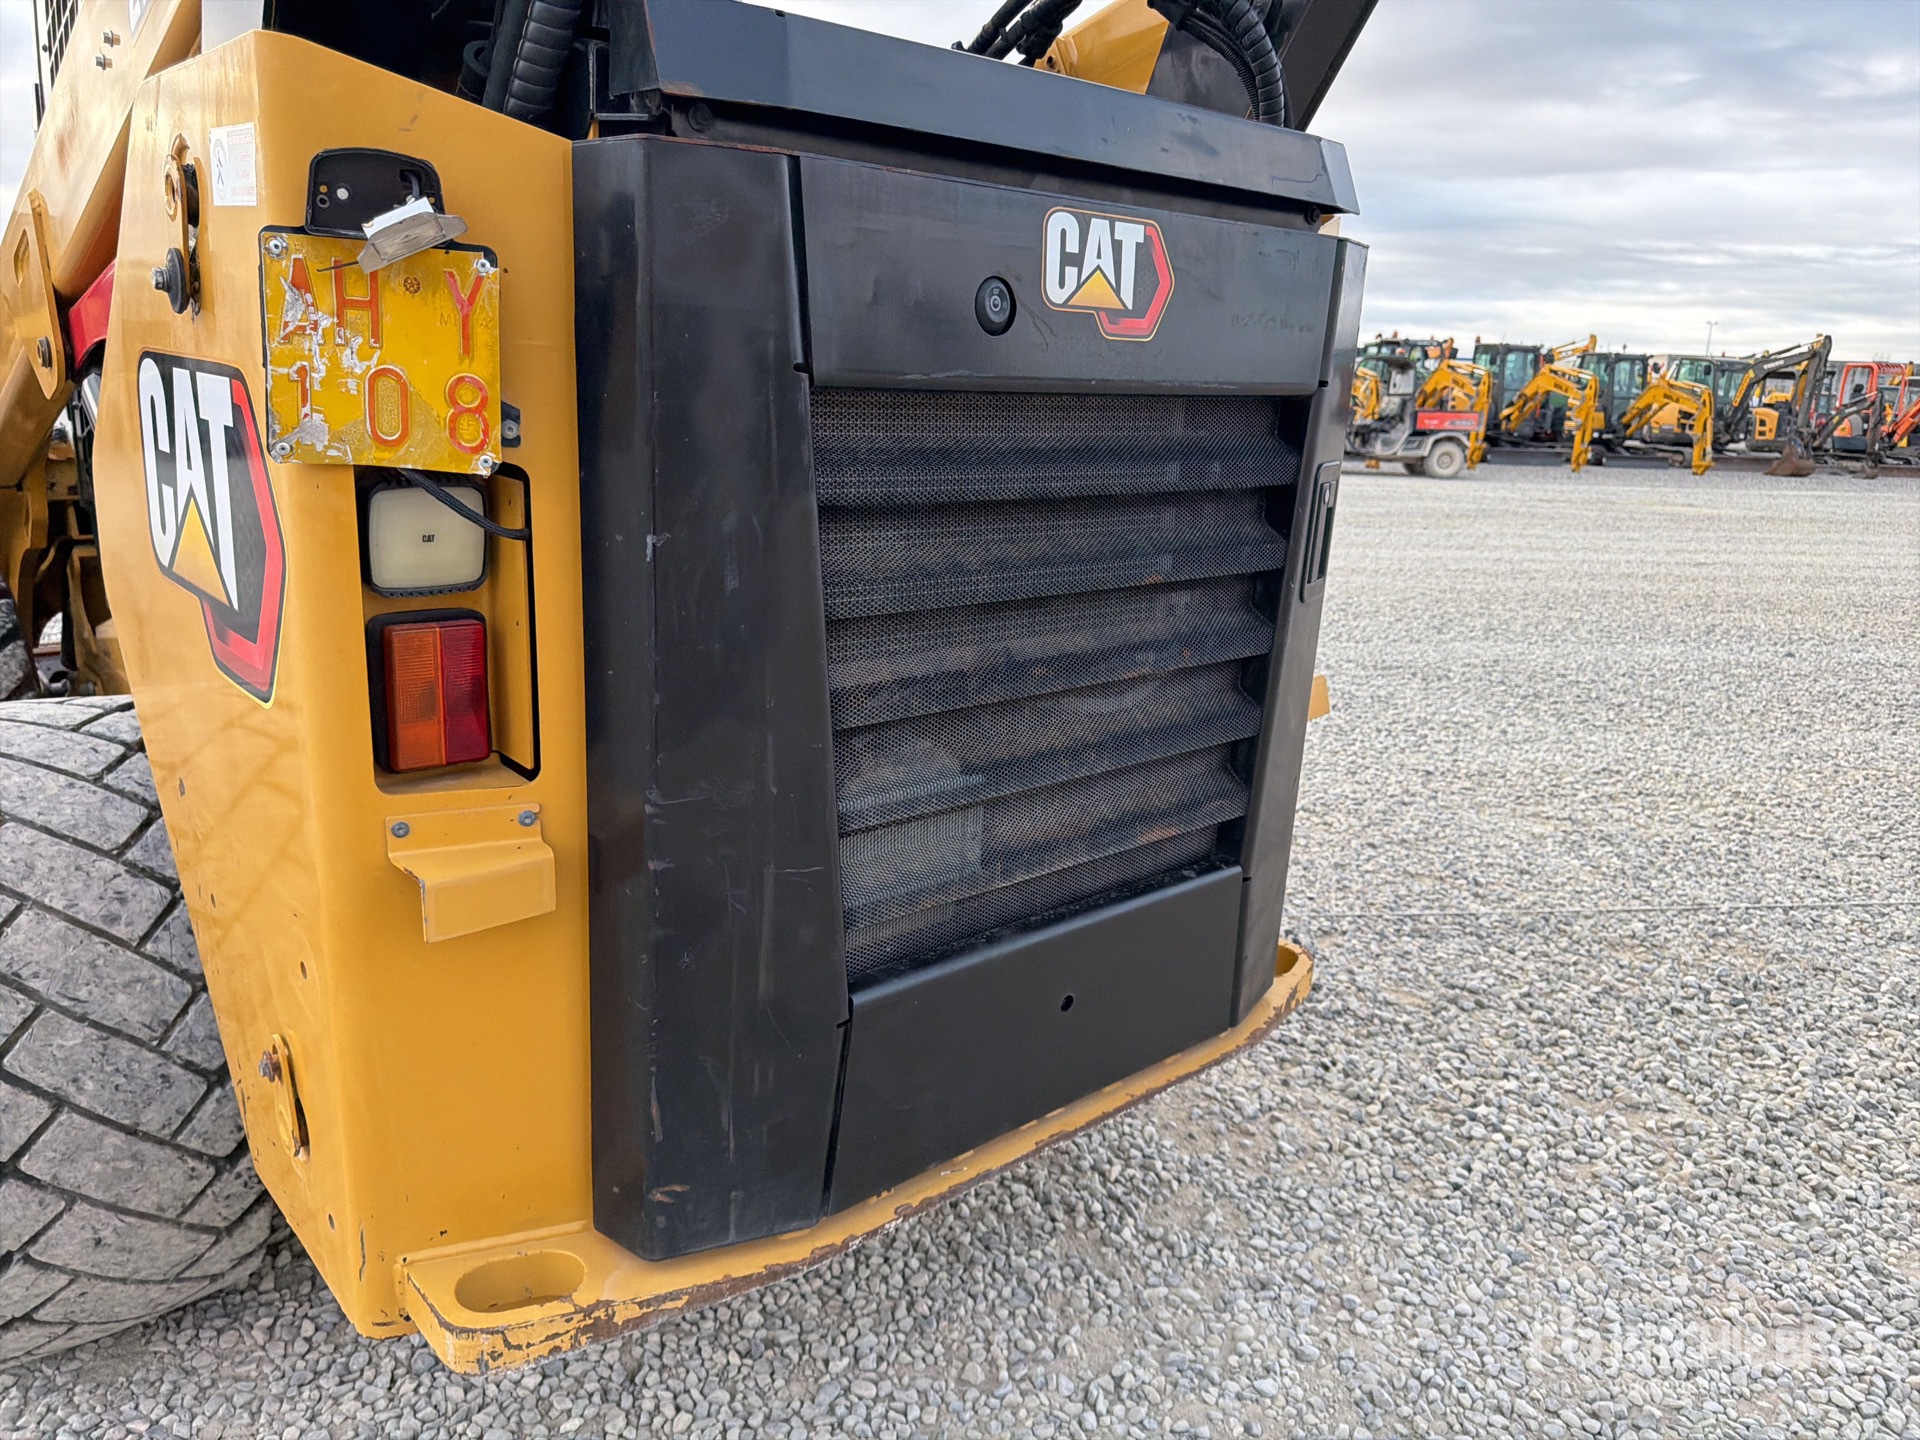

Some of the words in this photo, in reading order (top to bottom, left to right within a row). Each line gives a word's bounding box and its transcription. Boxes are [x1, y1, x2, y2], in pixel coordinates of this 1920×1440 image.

[1046, 211, 1145, 310] CAT
[288, 361, 491, 456] 108
[139, 357, 239, 612] CAT
[422, 534, 436, 543] CAT
